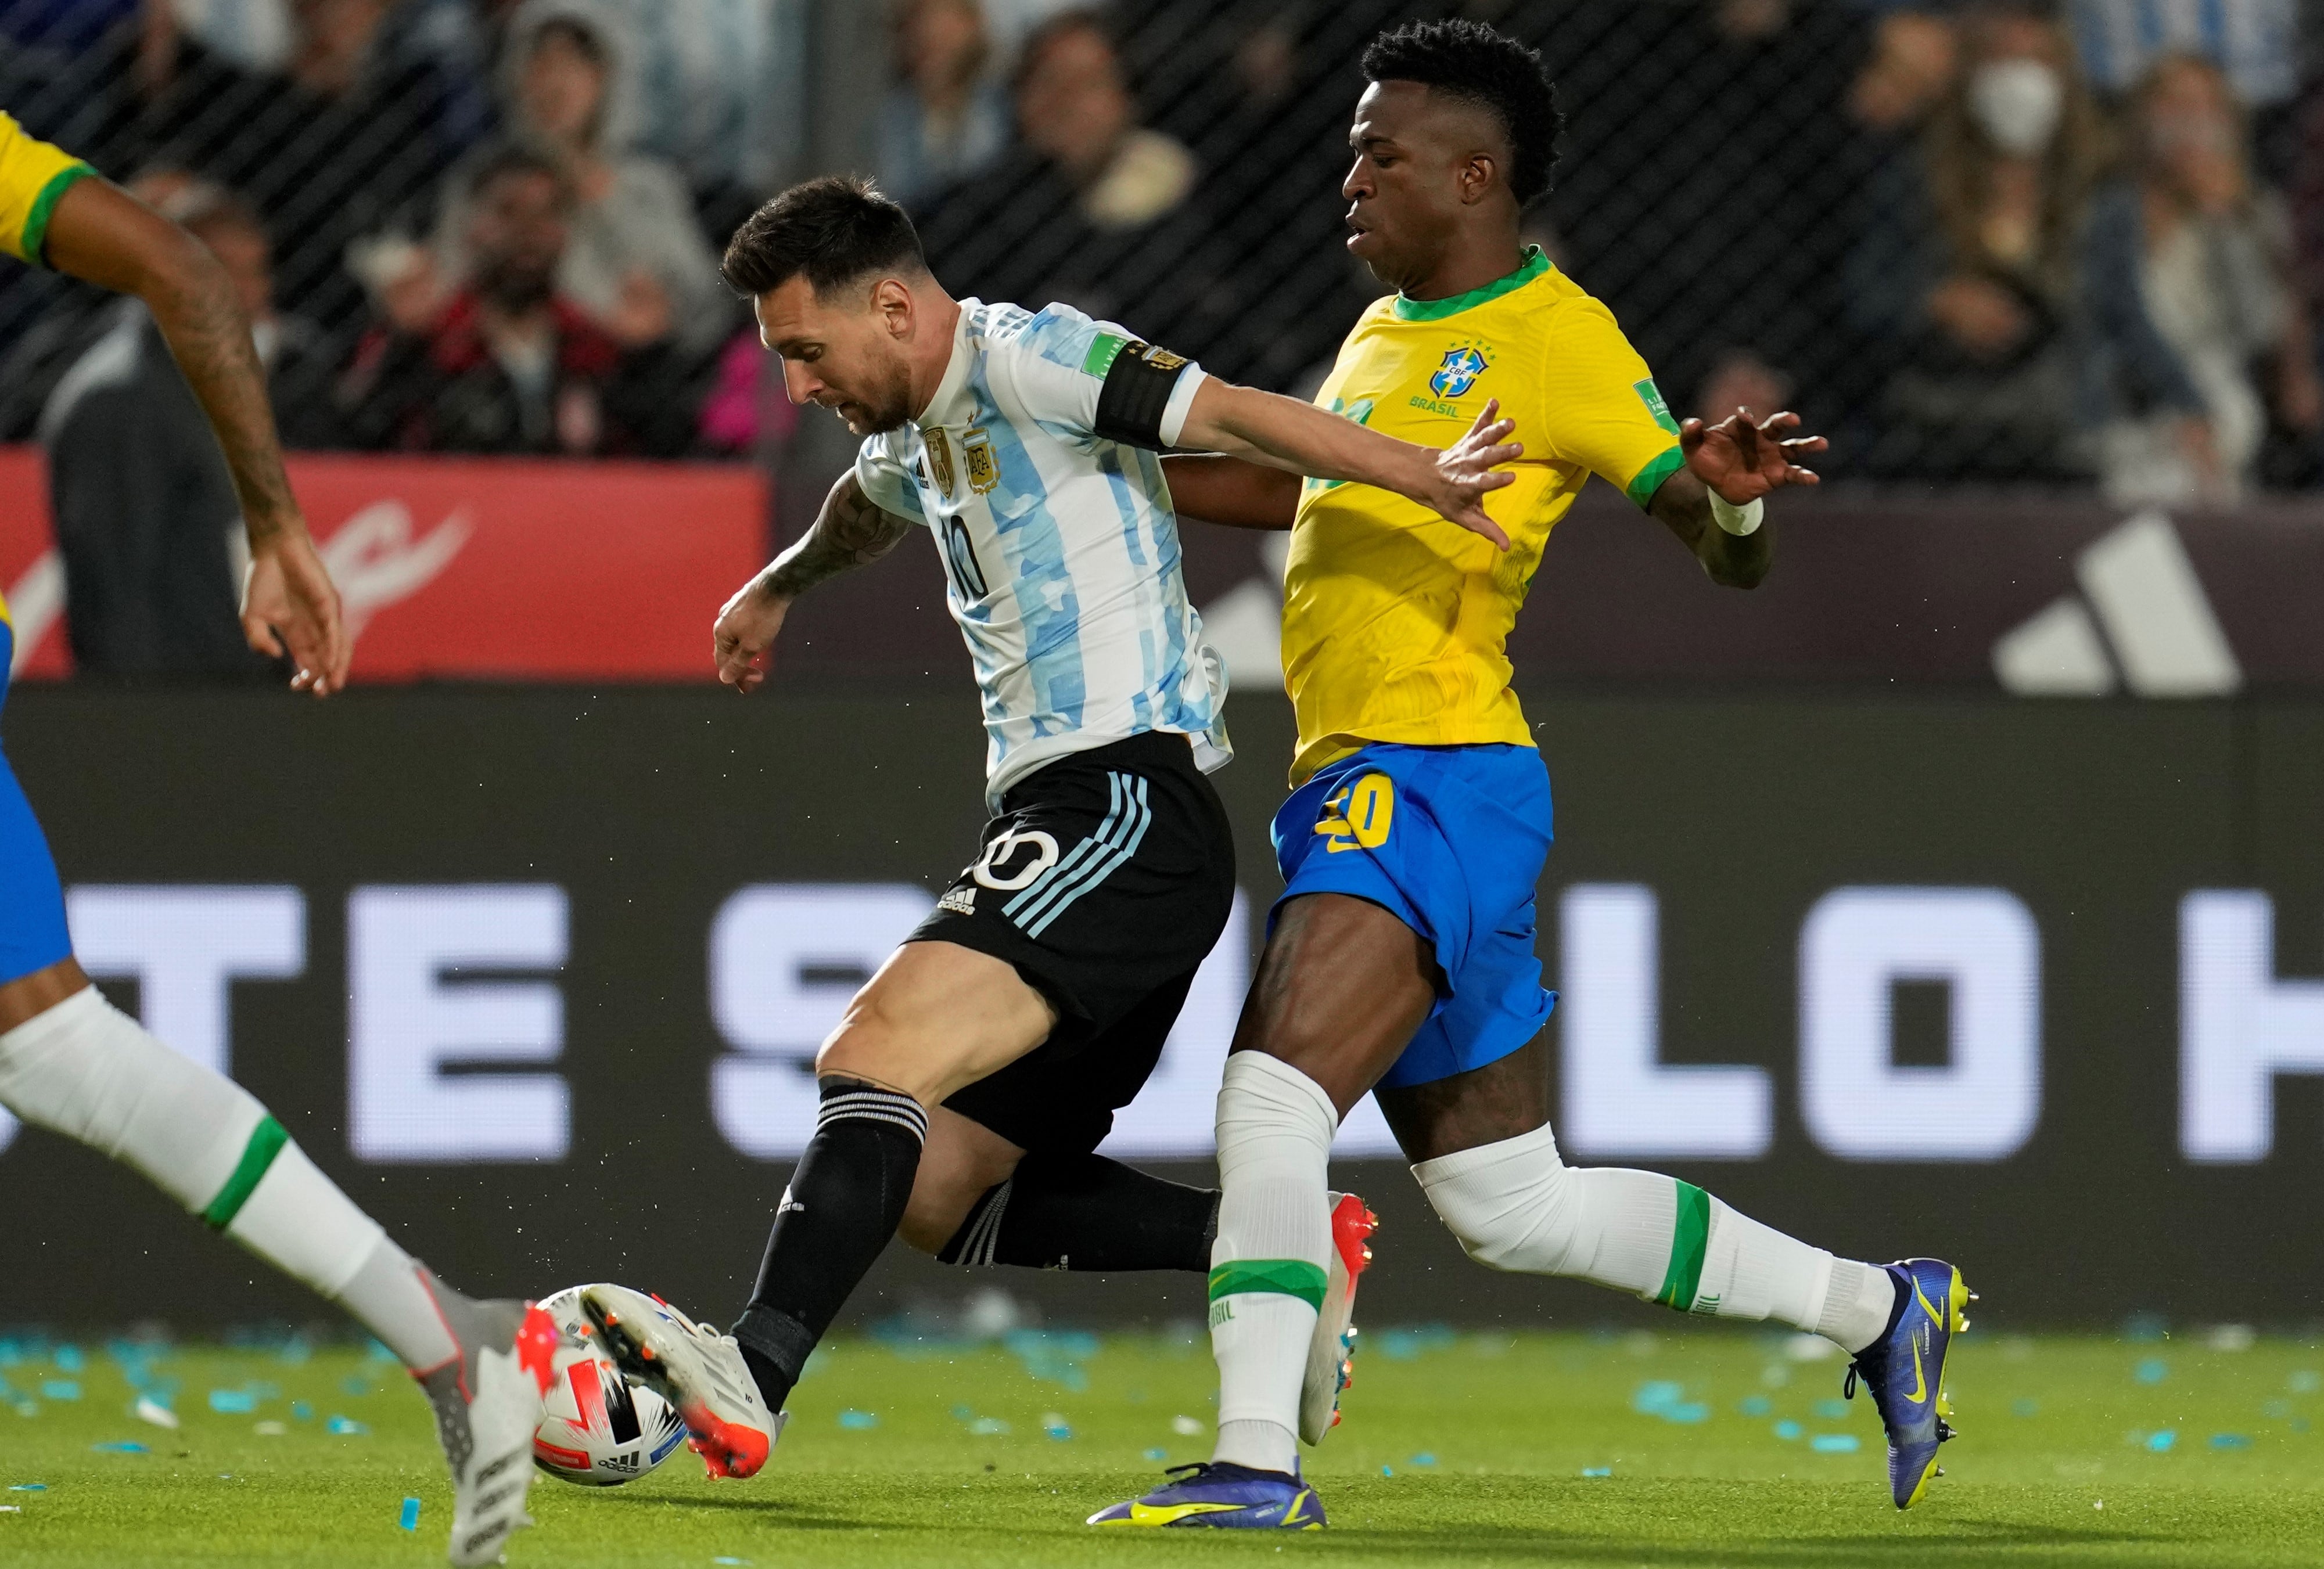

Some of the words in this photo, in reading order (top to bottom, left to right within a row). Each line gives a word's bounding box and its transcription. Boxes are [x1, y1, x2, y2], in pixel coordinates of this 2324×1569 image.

[1449, 367, 1466, 376] CBF
[1409, 396, 1459, 418] BRASIL
[972, 447, 990, 476] AFA
[941, 514, 989, 610] 10
[937, 899, 975, 916] adidas
[0, 883, 569, 1160] TE
[745, 1393, 753, 1404] 10
[598, 1459, 640, 1473] adidas
